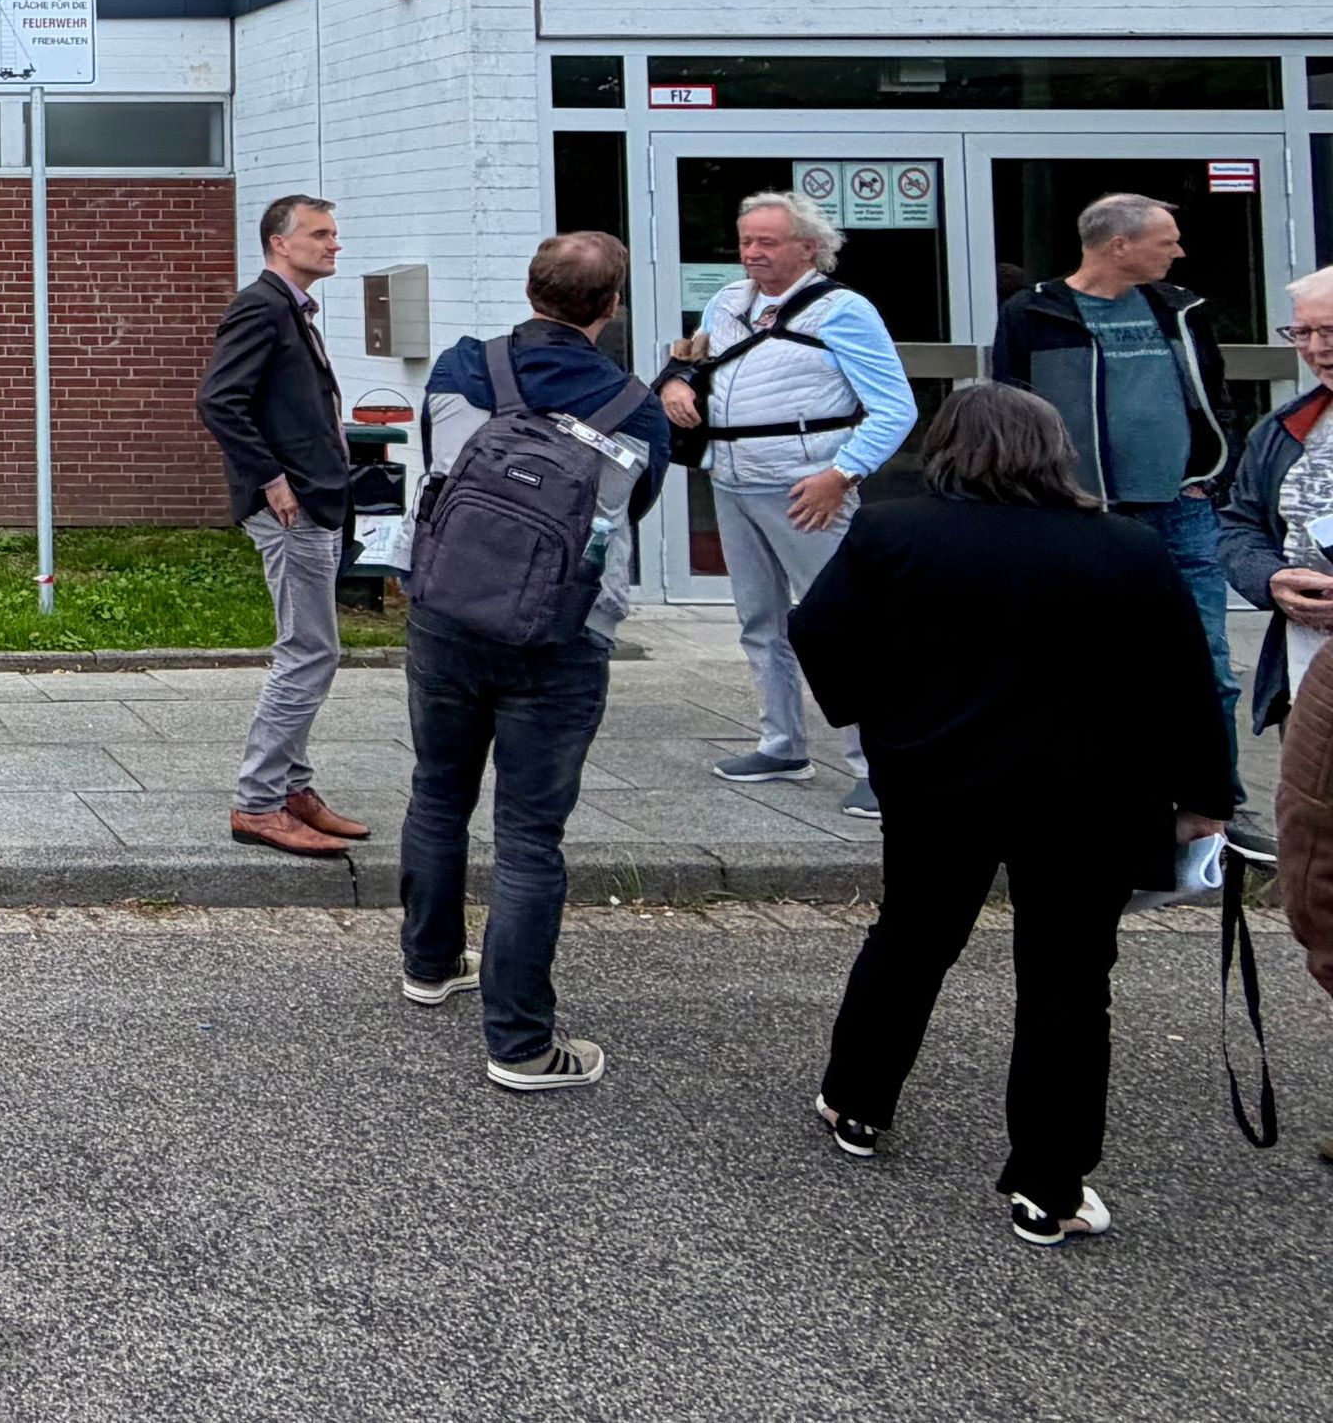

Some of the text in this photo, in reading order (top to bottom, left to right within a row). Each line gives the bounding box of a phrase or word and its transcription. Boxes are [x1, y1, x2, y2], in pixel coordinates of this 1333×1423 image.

[13, 0, 88, 10] FLÄCHE FÜR DIE
[22, 18, 88, 29] FEUERWEHR
[32, 37, 88, 45] FREIHALTEN
[671, 90, 692, 102] FIZ
